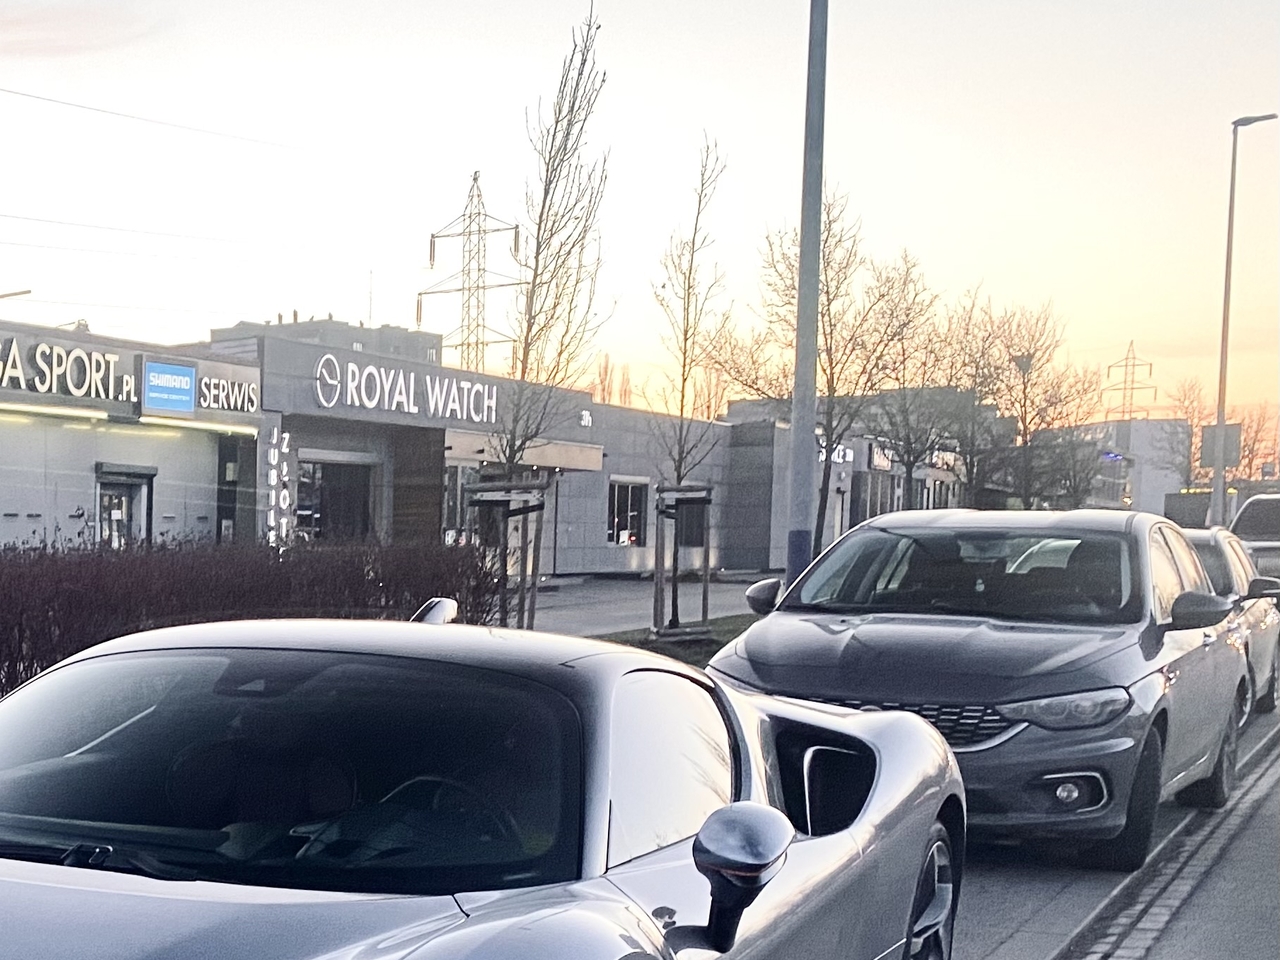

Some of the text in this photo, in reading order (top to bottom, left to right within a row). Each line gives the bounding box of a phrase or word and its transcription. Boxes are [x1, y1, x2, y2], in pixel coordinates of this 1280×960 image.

[149, 372, 191, 390] SHIMANO
[200, 376, 258, 413] SERWIS
[346, 362, 498, 424] ROYAL WATCH
